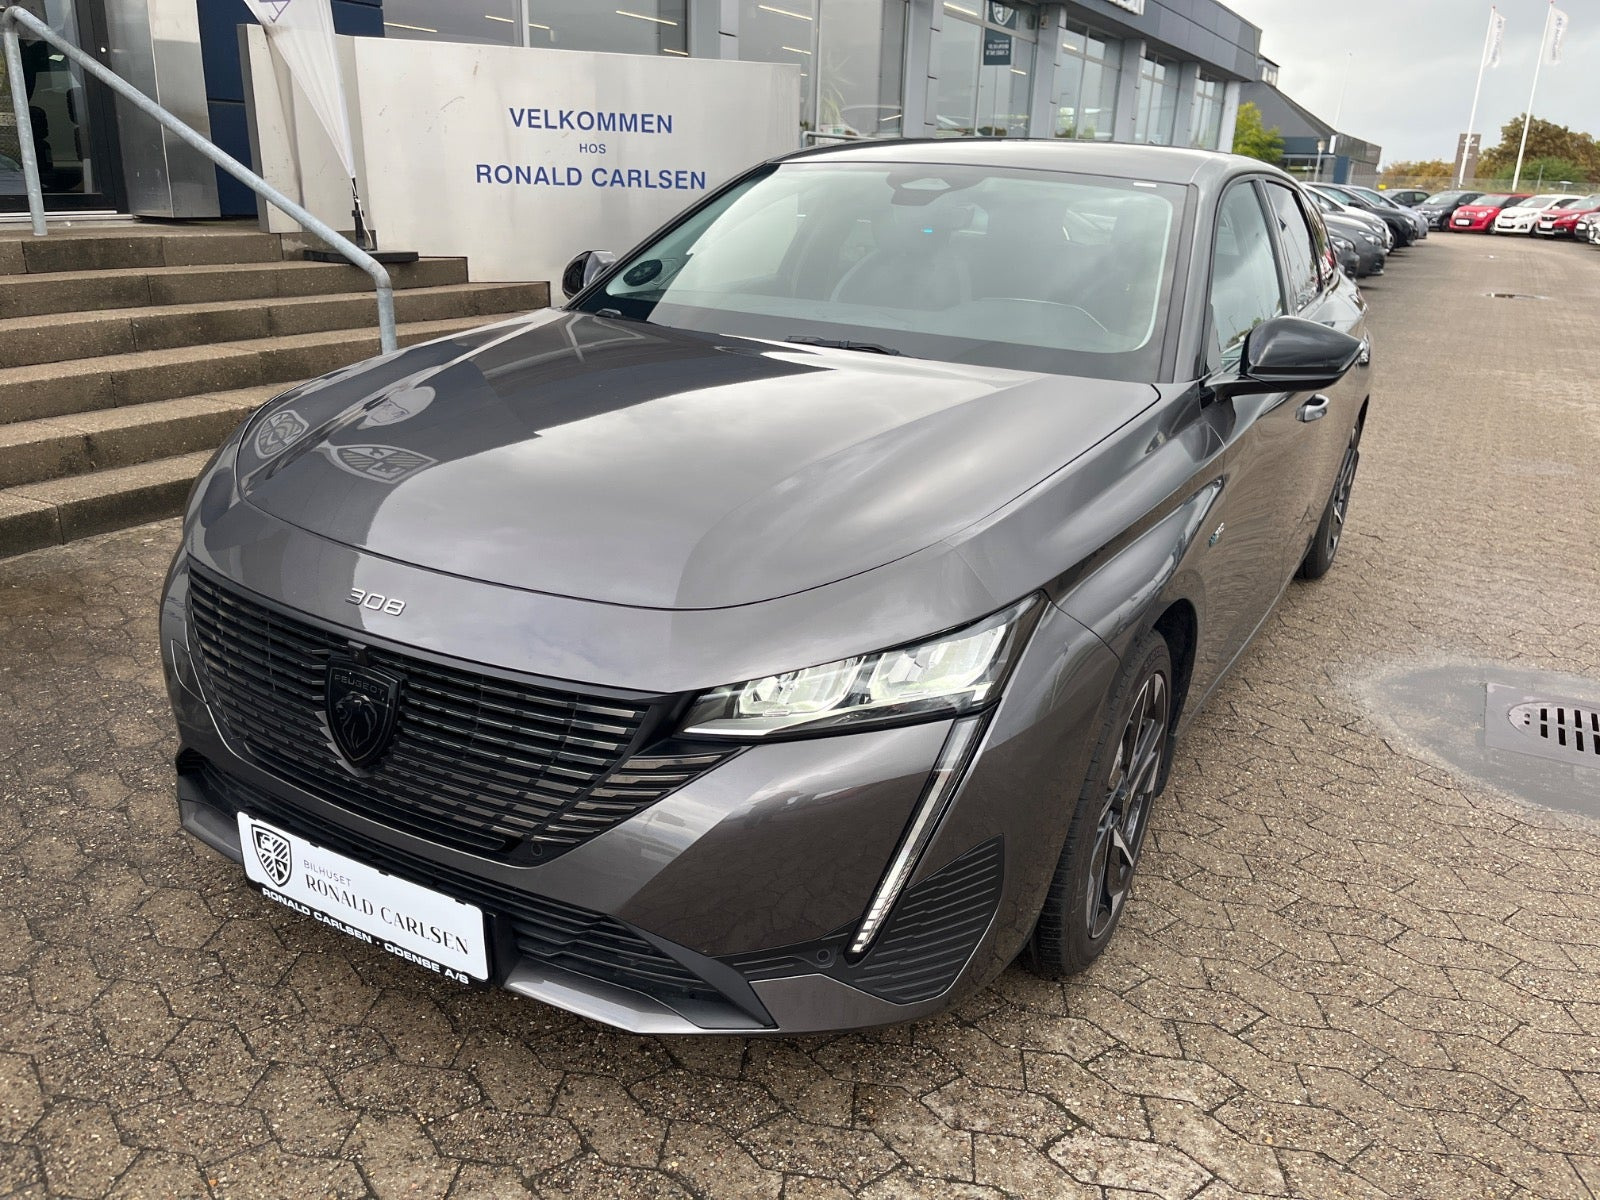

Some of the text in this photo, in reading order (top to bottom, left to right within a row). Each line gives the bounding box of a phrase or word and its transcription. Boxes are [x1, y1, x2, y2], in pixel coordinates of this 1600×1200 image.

[508, 107, 673, 134] VELKOMMEN
[578, 143, 607, 155] HOS
[475, 164, 706, 190] RONALD CARLSEN
[345, 587, 406, 617] 308
[334, 674, 386, 696] PEUGEOT
[303, 859, 352, 887] BILHUSET
[305, 873, 470, 956] RONALD CARLSEN
[261, 887, 470, 985] RONALD CARLSEN ODENSE A/S
